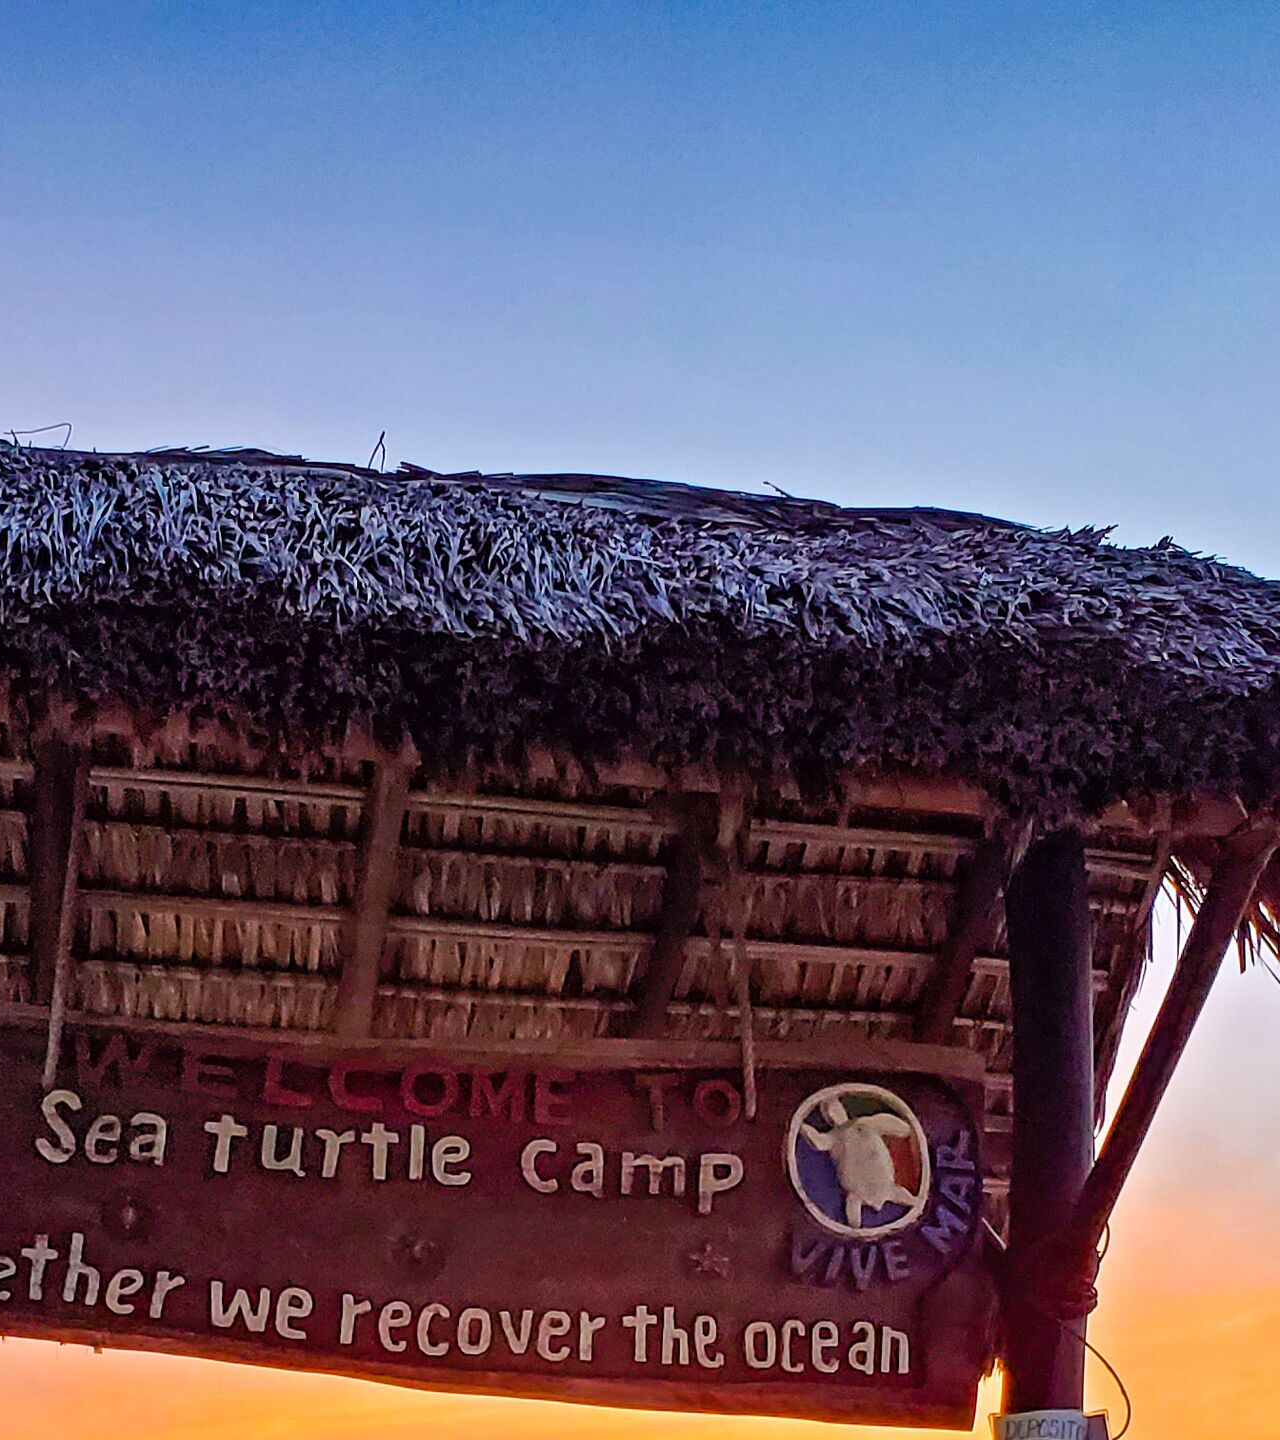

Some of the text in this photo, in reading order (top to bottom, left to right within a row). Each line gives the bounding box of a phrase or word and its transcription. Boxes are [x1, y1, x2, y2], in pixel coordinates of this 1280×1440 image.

[75, 1033, 742, 1133] WELCOME TO
[34, 1088, 745, 1215] Sea turtle camp
[791, 1129, 976, 1291] VIVE MAR
[209, 1279, 313, 1340] we
[339, 1292, 606, 1363] recover
[621, 1304, 725, 1370] the
[744, 1319, 912, 1375] ocean
